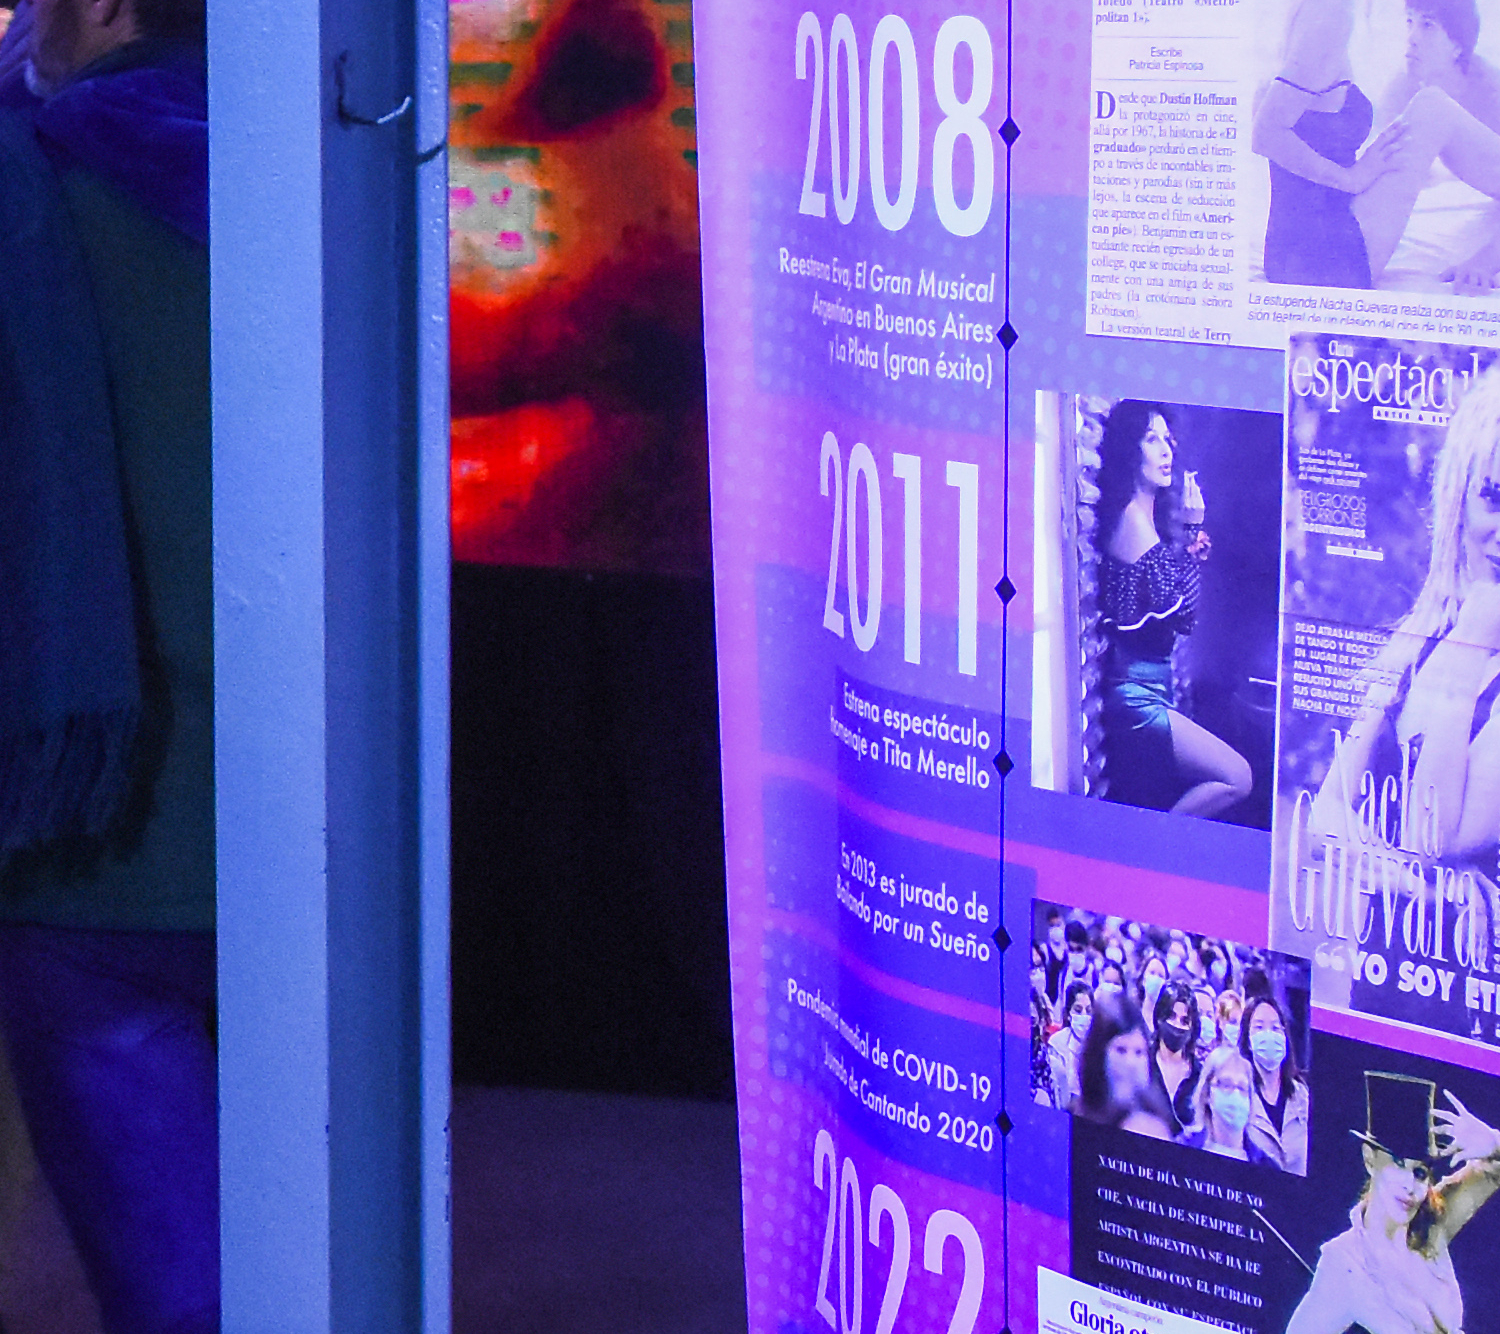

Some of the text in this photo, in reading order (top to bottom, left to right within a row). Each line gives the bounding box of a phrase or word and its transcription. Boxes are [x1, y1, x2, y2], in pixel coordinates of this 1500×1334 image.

[795, 11, 995, 238] 2008
[819, 430, 980, 677] 2011
[883, 703, 991, 751] espectáculo
[1331, 728, 1444, 859] Nacha
[880, 874, 990, 924] es jurado de
[1288, 789, 1489, 973] Guevara
[1397, 960, 1457, 1003] SOY
[872, 1037, 992, 1103] de COVID-19
[859, 1079, 994, 1153] Cantando 2020
[1226, 1189, 1243, 1205] DE
